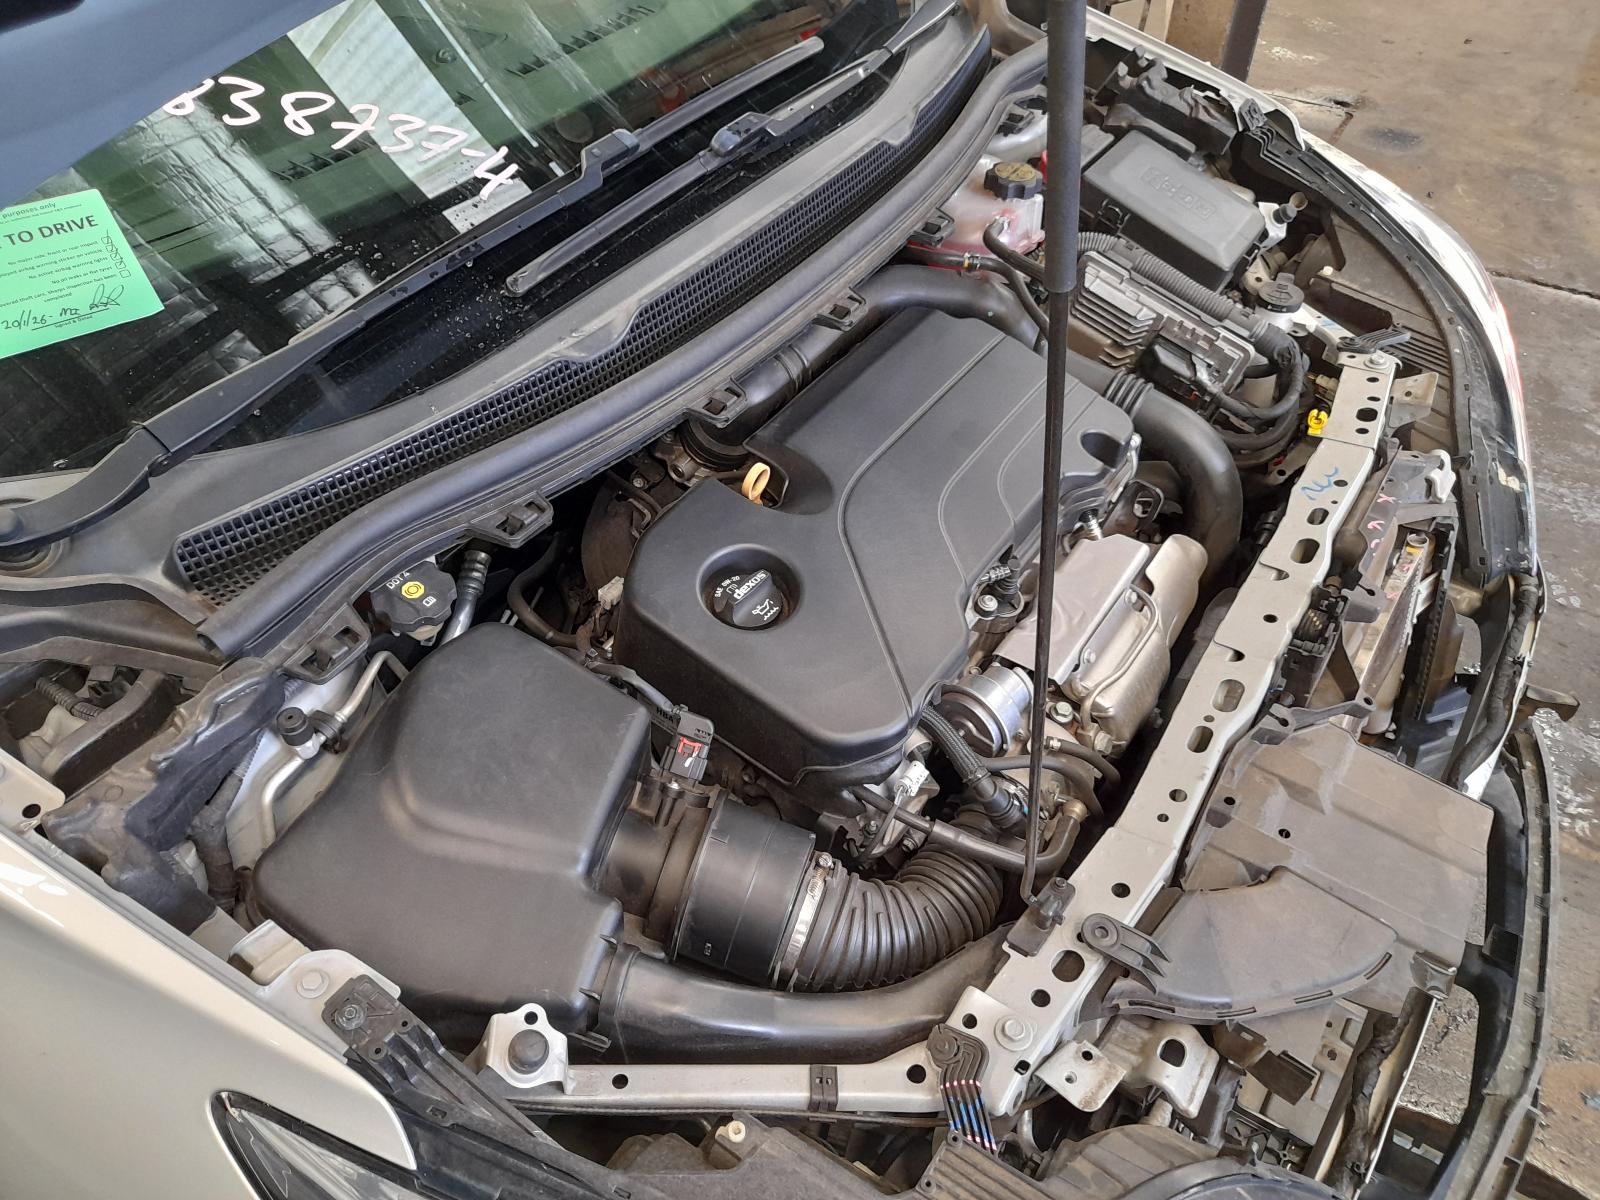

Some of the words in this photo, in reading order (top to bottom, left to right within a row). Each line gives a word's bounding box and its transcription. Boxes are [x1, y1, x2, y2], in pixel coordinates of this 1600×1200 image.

[39, 202, 56, 210] only
[3, 230, 34, 245] TO
[38, 215, 99, 238] DRIVE
[733, 570, 767, 600] dexos
